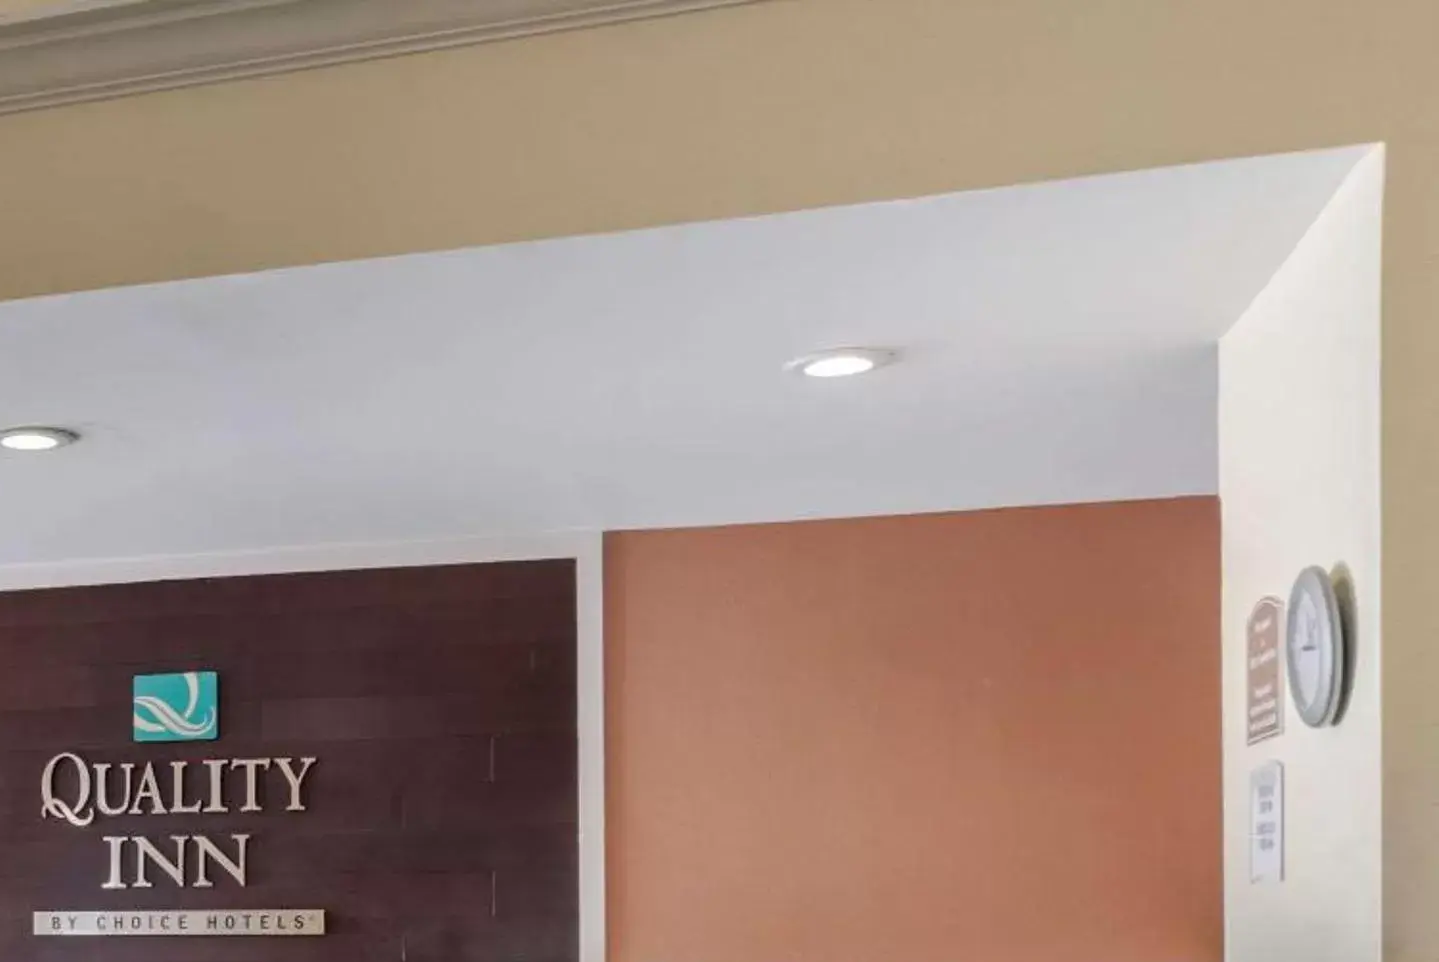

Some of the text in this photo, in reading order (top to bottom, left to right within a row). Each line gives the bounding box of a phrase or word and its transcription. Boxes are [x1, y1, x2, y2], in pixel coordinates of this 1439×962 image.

[41, 752, 317, 826] QUALITY
[101, 834, 251, 889] INN
[51, 914, 305, 931] BY CHOICE HOTELS
